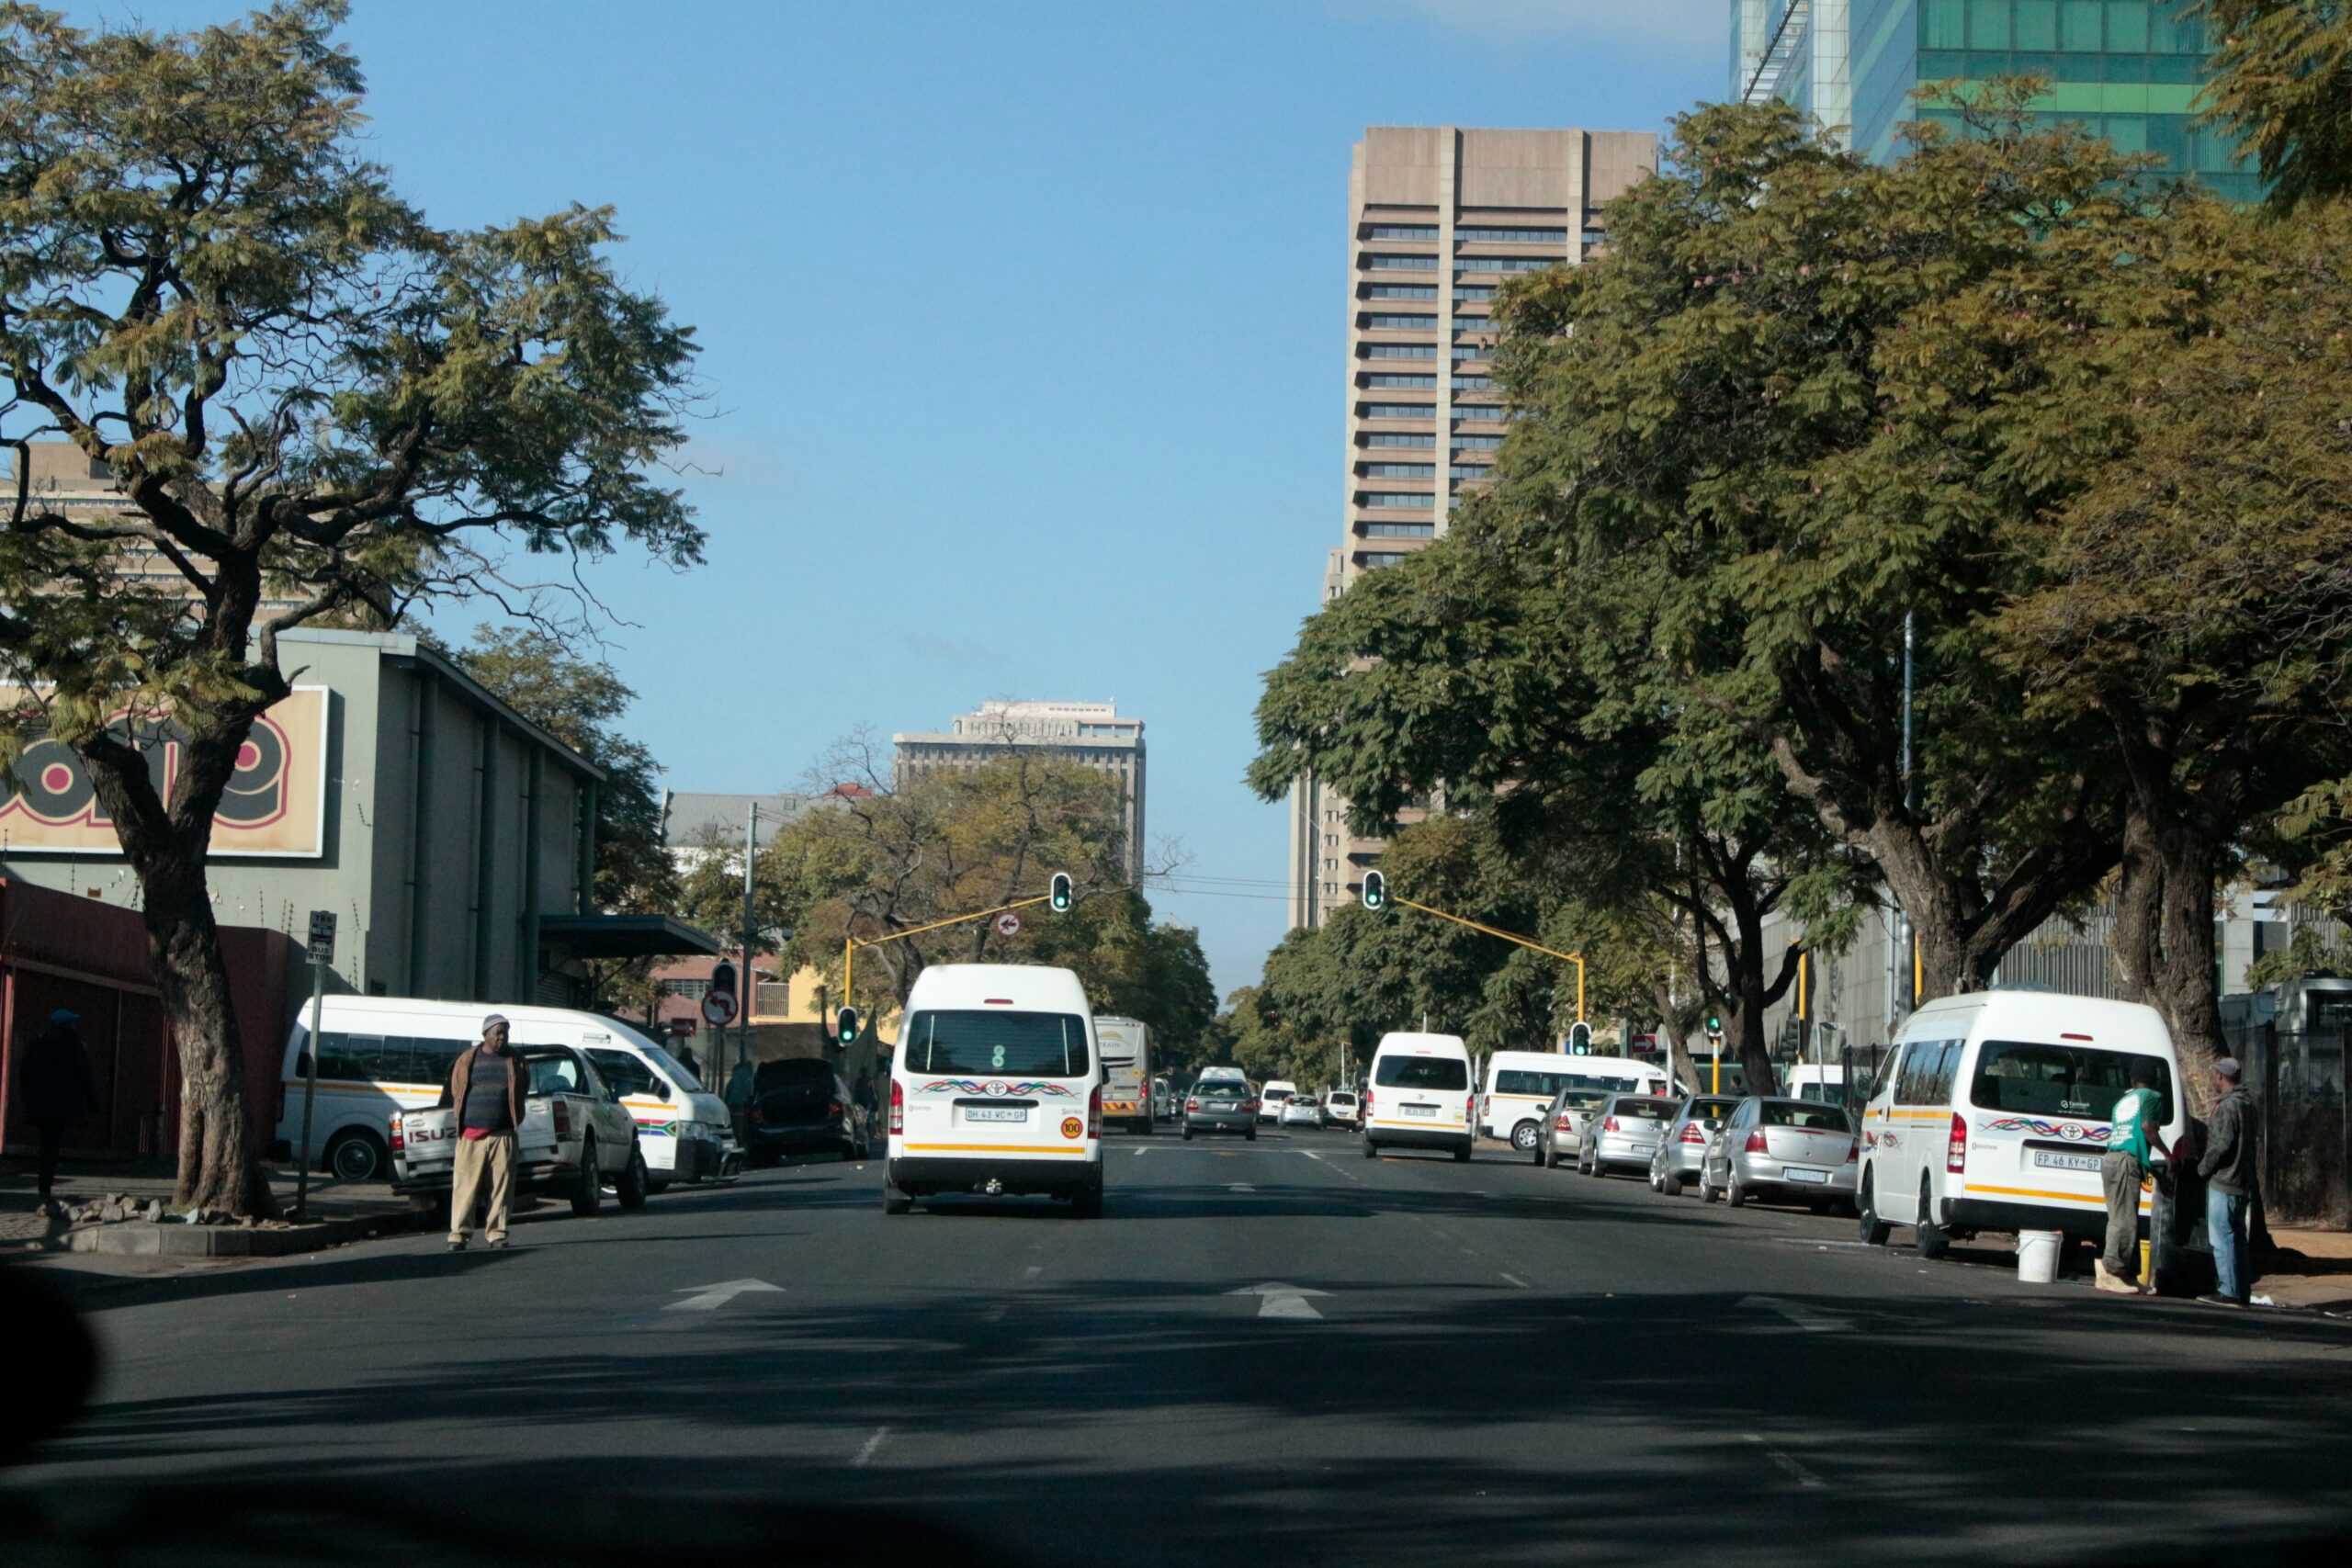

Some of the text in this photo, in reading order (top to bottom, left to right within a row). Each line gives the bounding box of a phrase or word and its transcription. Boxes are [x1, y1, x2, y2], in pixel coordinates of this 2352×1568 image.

[311, 946, 330, 954] BUS
[308, 953, 332, 962] STOP
[967, 1110, 978, 1118] DH
[981, 1110, 992, 1119] 43
[1013, 1111, 1025, 1120] GP
[1064, 1122, 1080, 1134] 100
[409, 1127, 458, 1144] ISUZ
[2037, 1153, 2100, 1169] FP 46 KY GP
